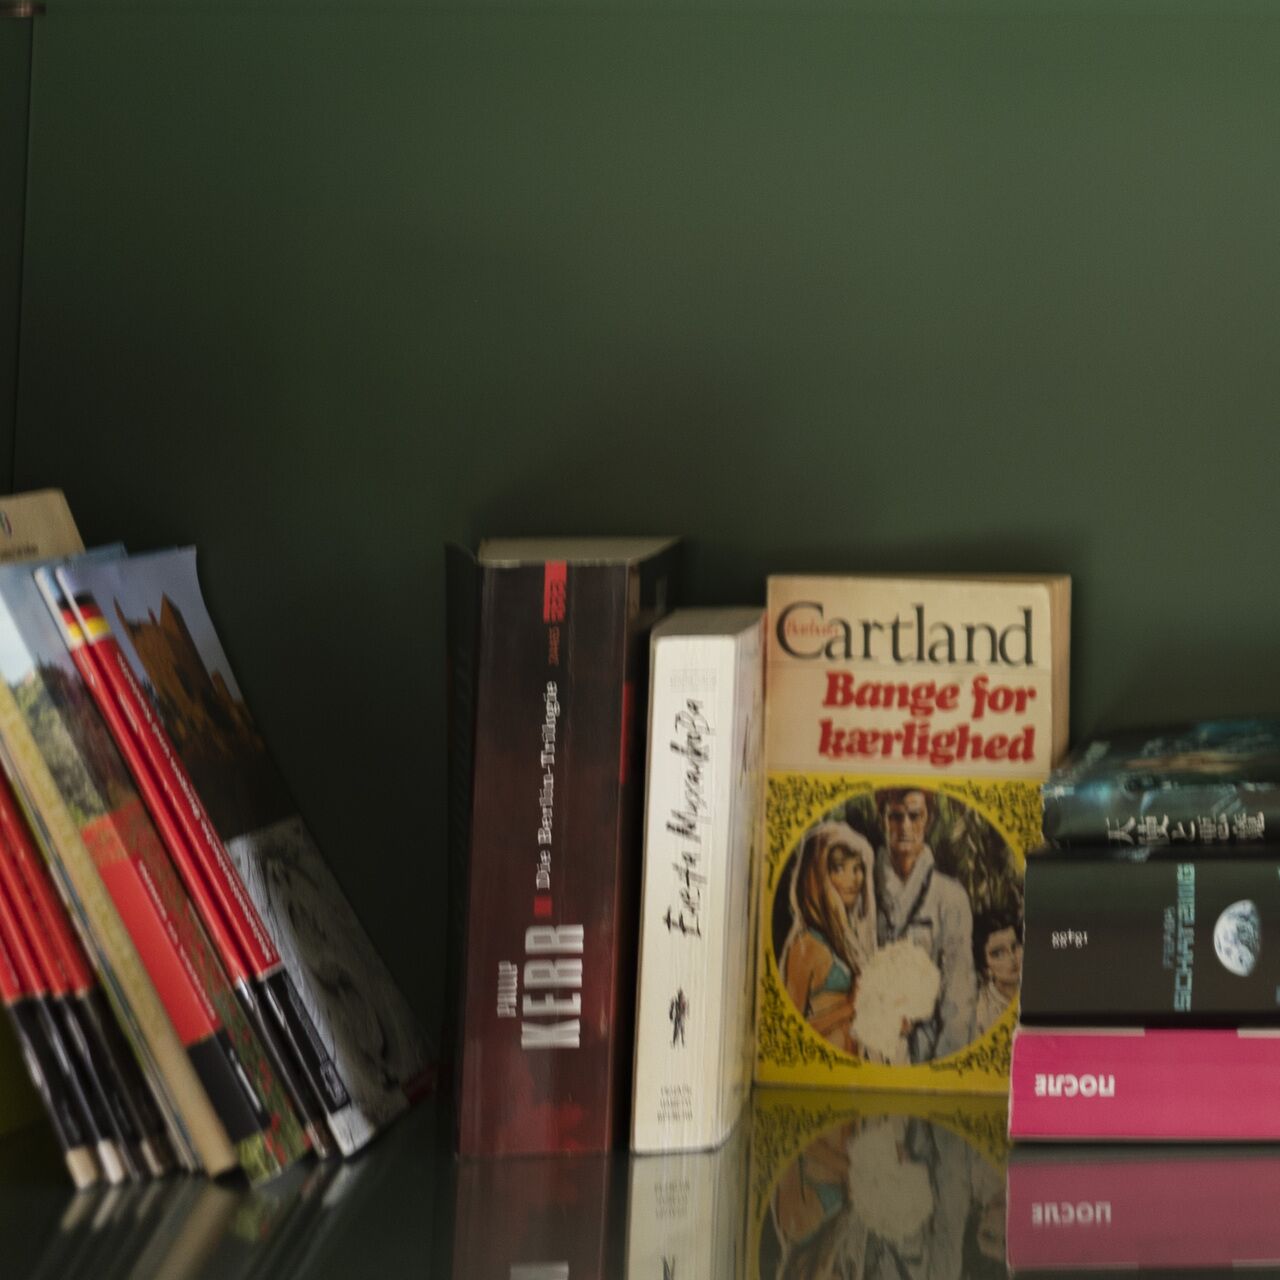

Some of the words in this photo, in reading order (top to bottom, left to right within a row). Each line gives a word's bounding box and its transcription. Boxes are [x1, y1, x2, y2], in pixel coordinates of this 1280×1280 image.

[775, 600, 1037, 666] Cartland
[822, 669, 960, 717] Bange
[971, 672, 1037, 720] for
[817, 716, 1036, 768] kærlighed
[520, 923, 585, 1050] KERR
[1033, 1073, 1116, 1099] ПОСЛЕ
